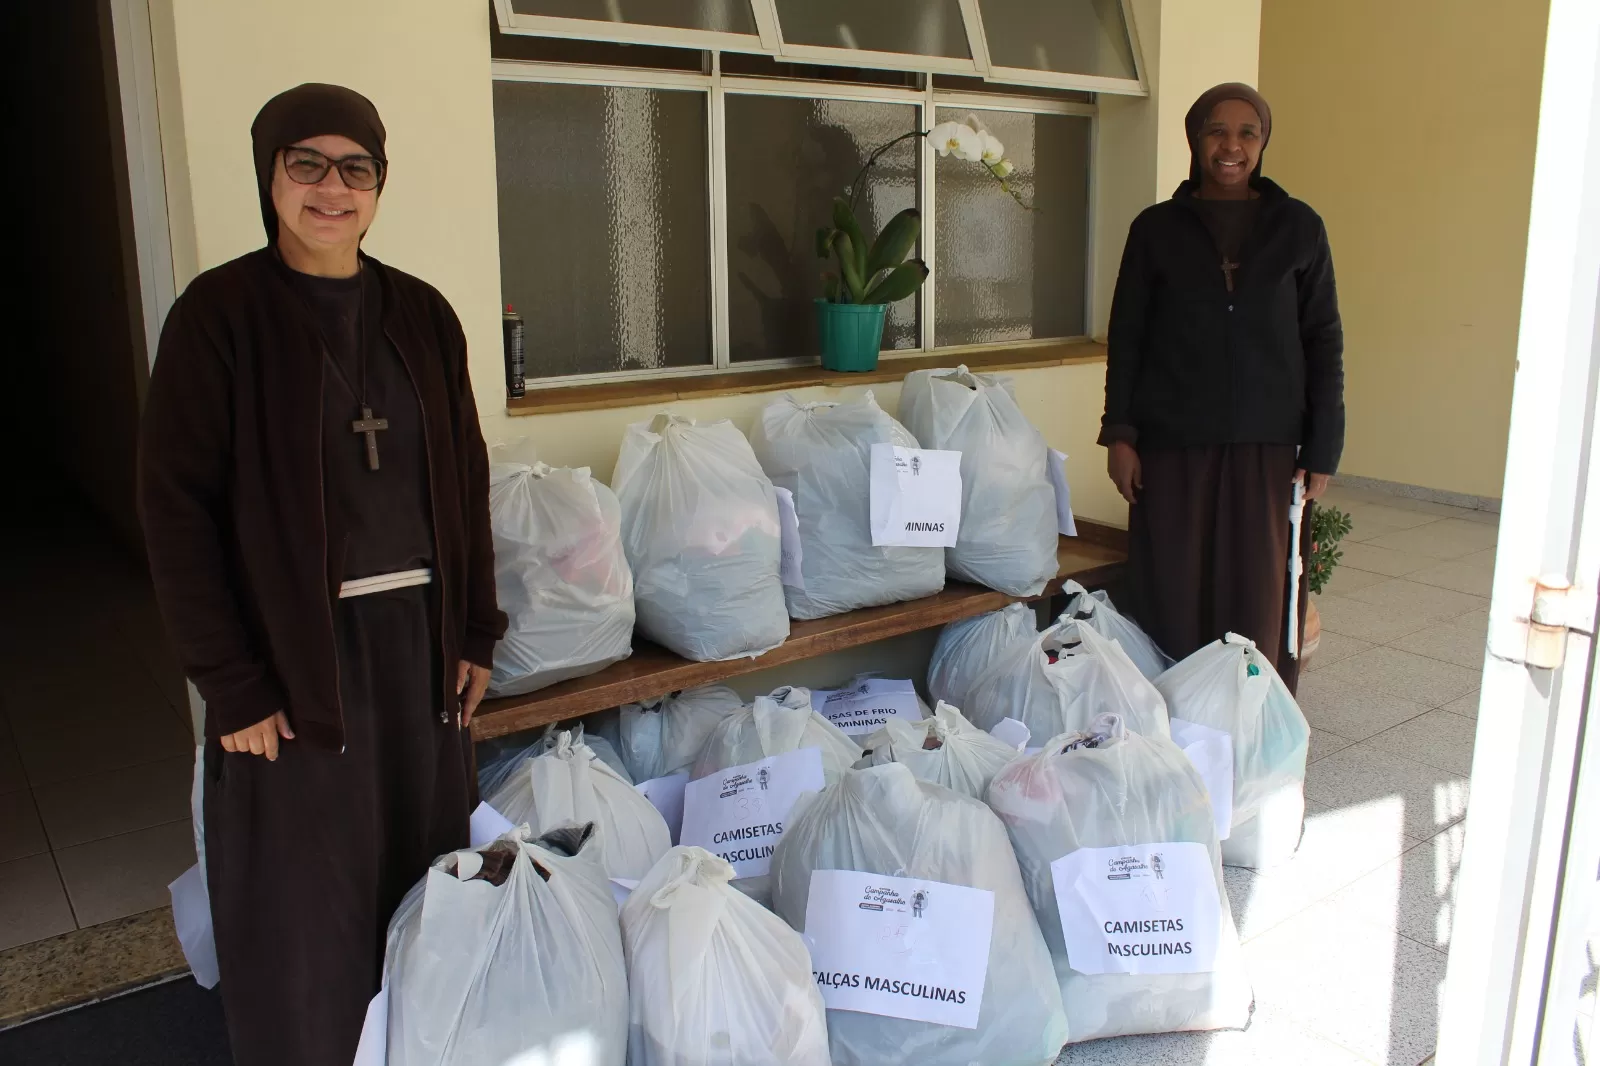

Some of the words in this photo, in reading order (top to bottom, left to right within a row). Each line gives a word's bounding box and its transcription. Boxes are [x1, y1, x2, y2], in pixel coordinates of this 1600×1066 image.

[855, 709, 869, 717] DE
[713, 822, 784, 844] CAMISETAS
[716, 845, 775, 864] ASCULIN
[1104, 919, 1184, 933] CAMISETAS
[864, 976, 966, 1004] MASCULINAS
